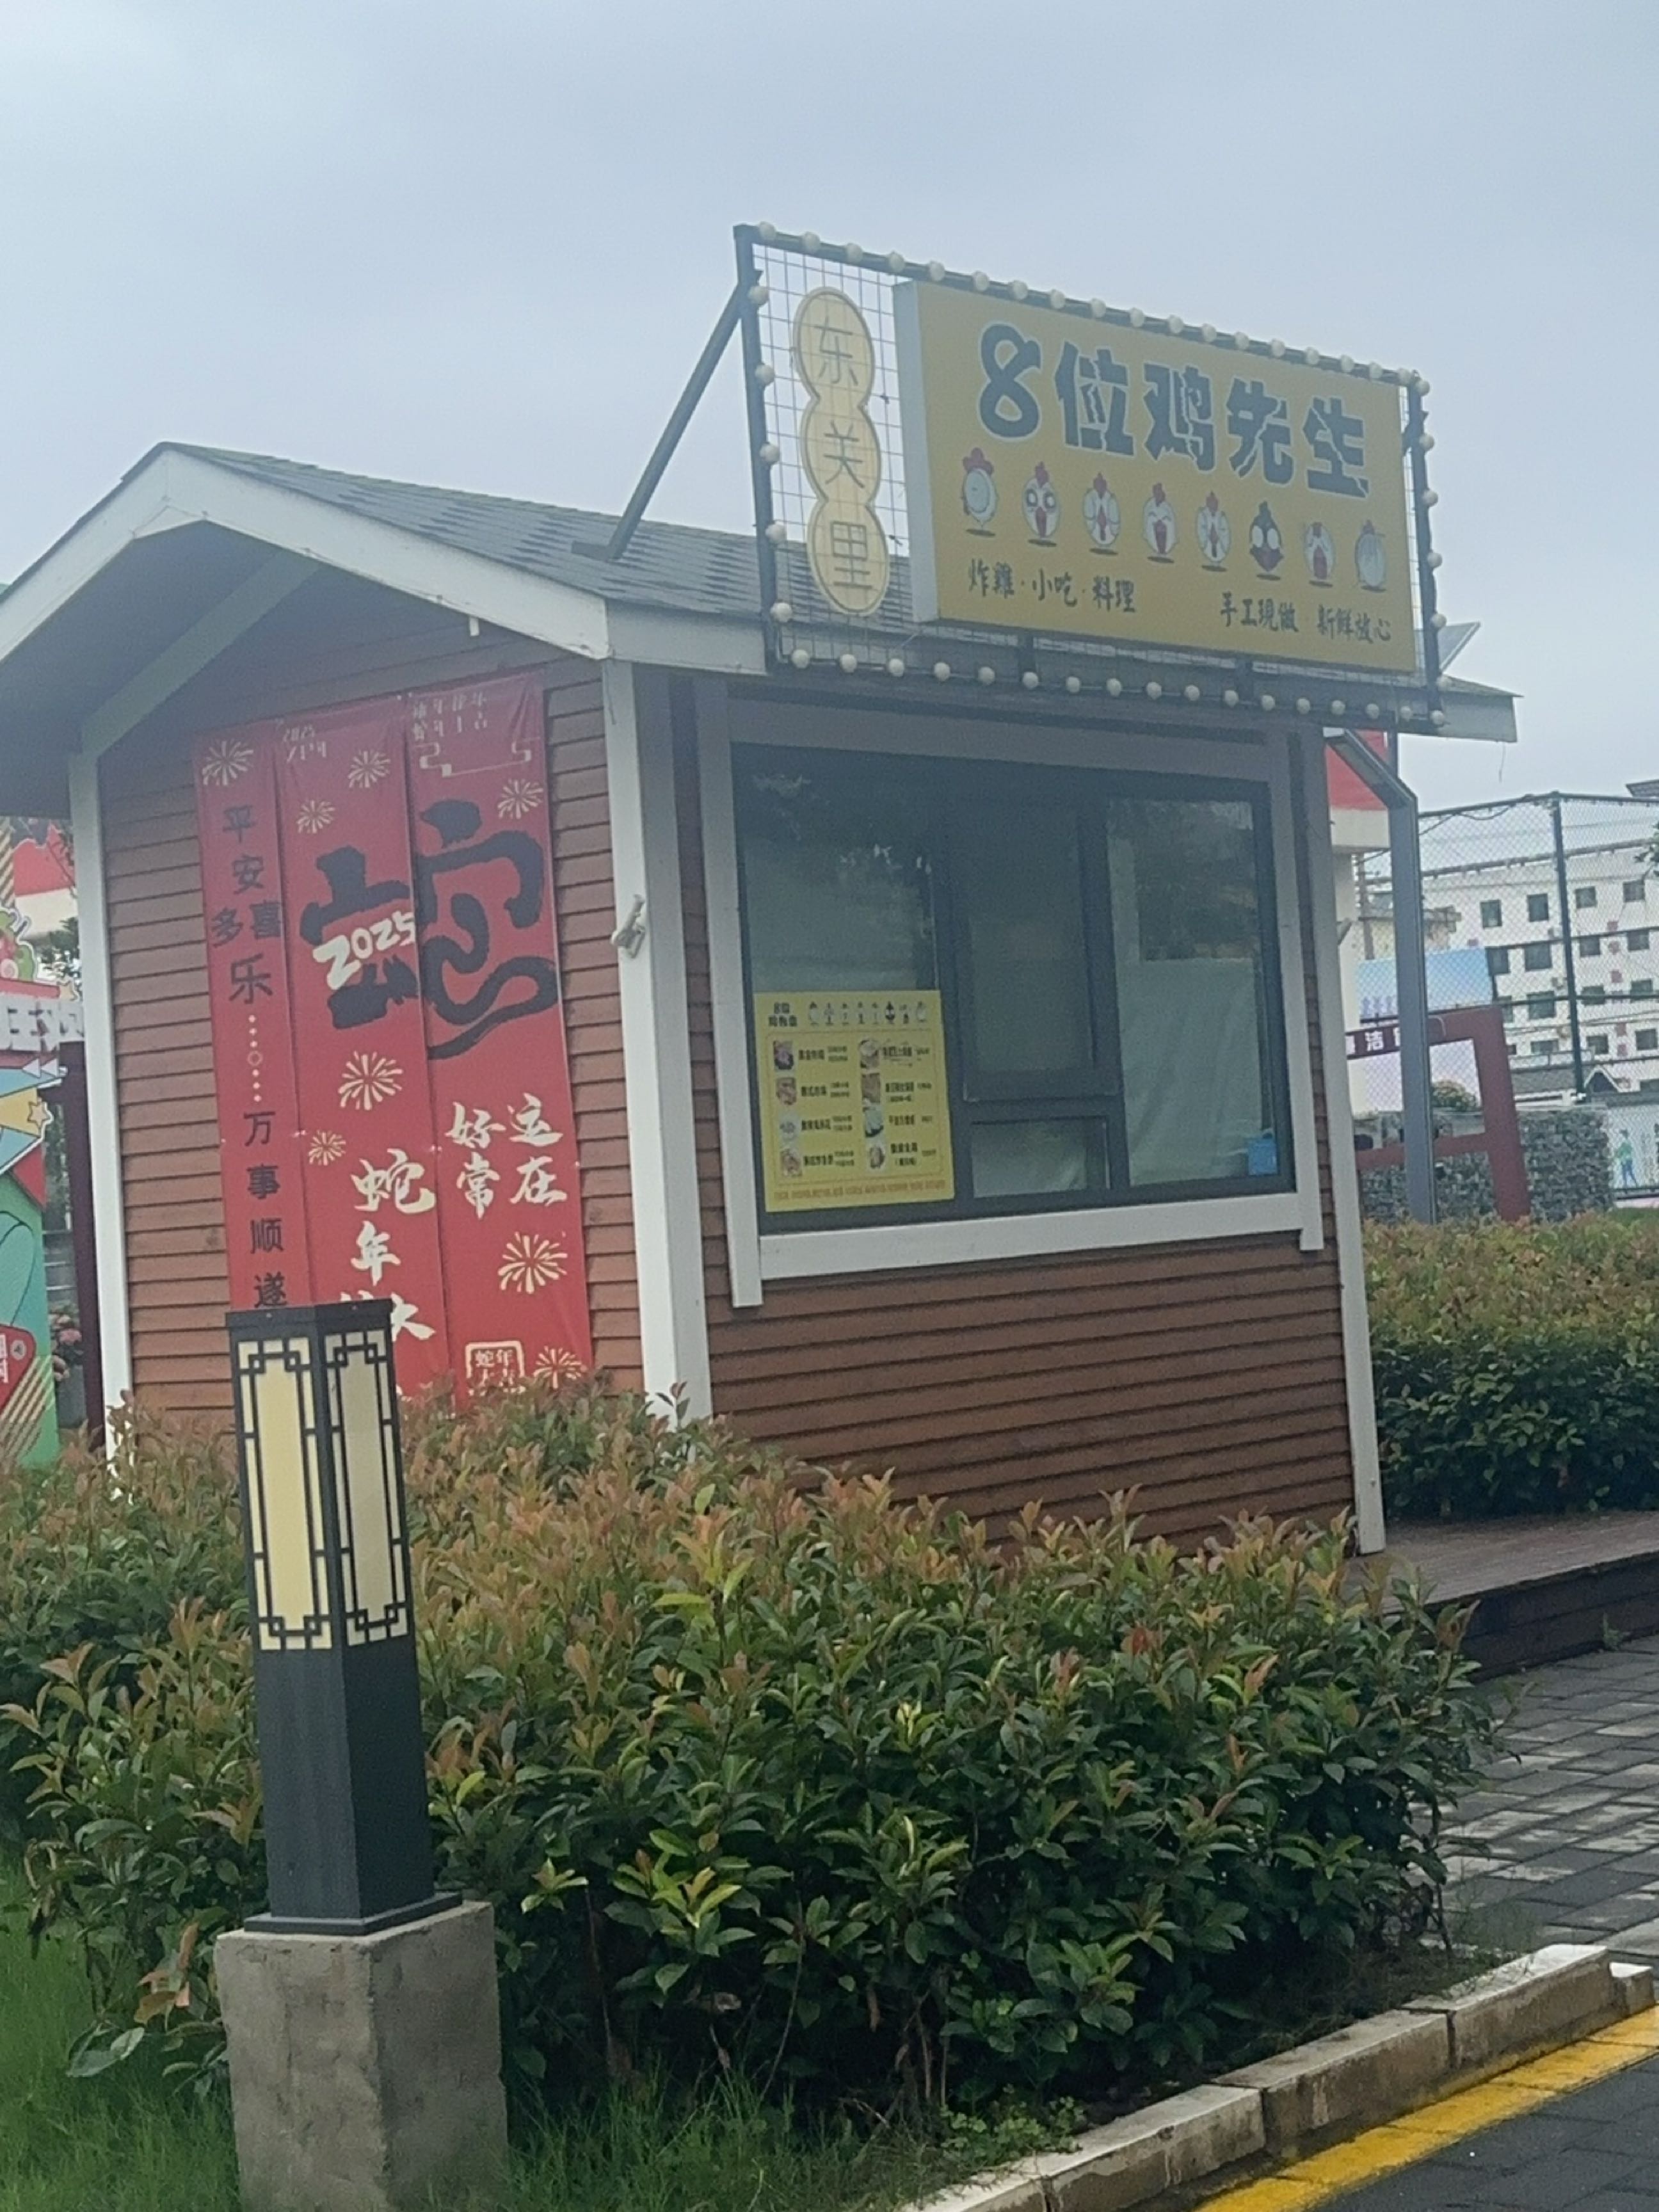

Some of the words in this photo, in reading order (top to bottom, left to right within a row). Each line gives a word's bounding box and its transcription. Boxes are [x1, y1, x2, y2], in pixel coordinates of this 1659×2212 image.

[814, 316, 874, 589] 东关里
[979, 324, 1370, 499] 8位鸡先生
[313, 910, 416, 990] 2025
[243, 1110, 287, 1309] 万事顺遂
